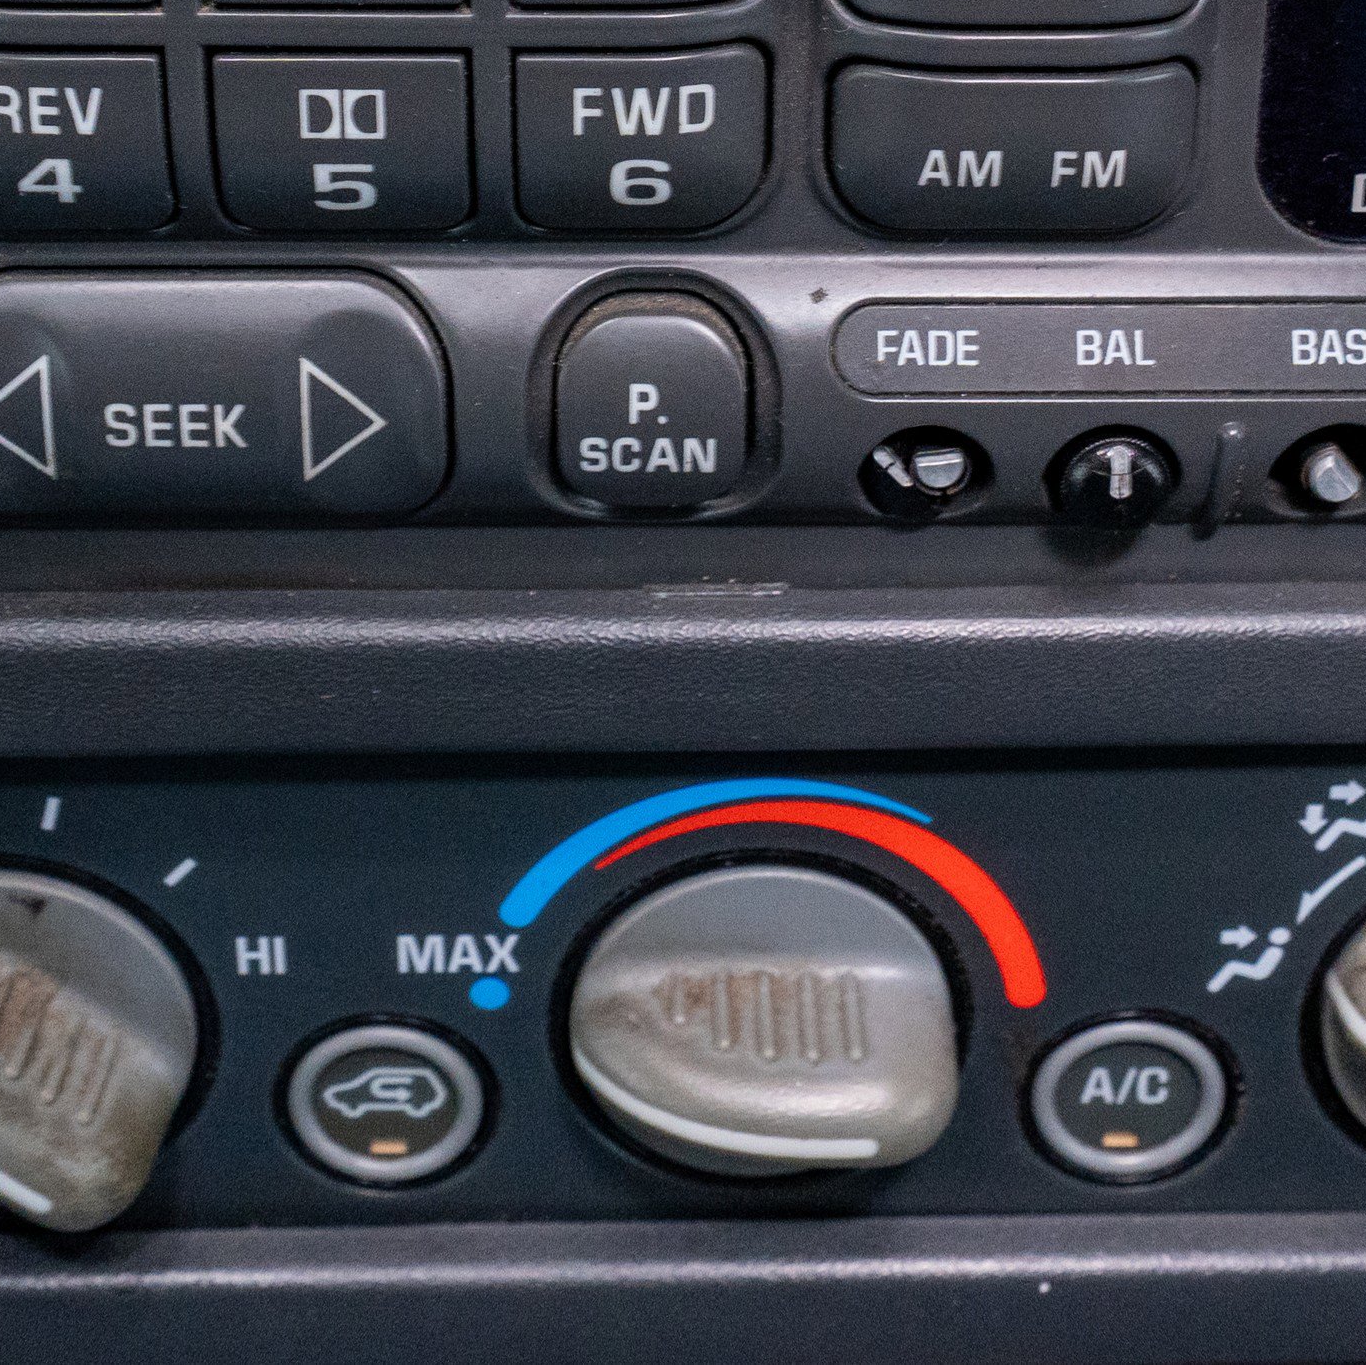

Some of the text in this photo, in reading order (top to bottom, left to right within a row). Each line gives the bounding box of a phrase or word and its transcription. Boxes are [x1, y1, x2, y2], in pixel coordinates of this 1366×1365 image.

[573, 83, 716, 136] FWD
[18, 158, 82, 203] 4
[312, 163, 377, 210] 5
[609, 158, 672, 205] 6
[918, 148, 1127, 188] AM FM
[877, 329, 980, 366] FADE
[1075, 329, 1156, 366] BAL
[628, 382, 668, 424] P.
[104, 402, 247, 448] SEEK
[579, 436, 717, 473] SCAN
[235, 936, 287, 975] HI
[397, 933, 520, 974] MAX
[1080, 1066, 1170, 1105] A/C
